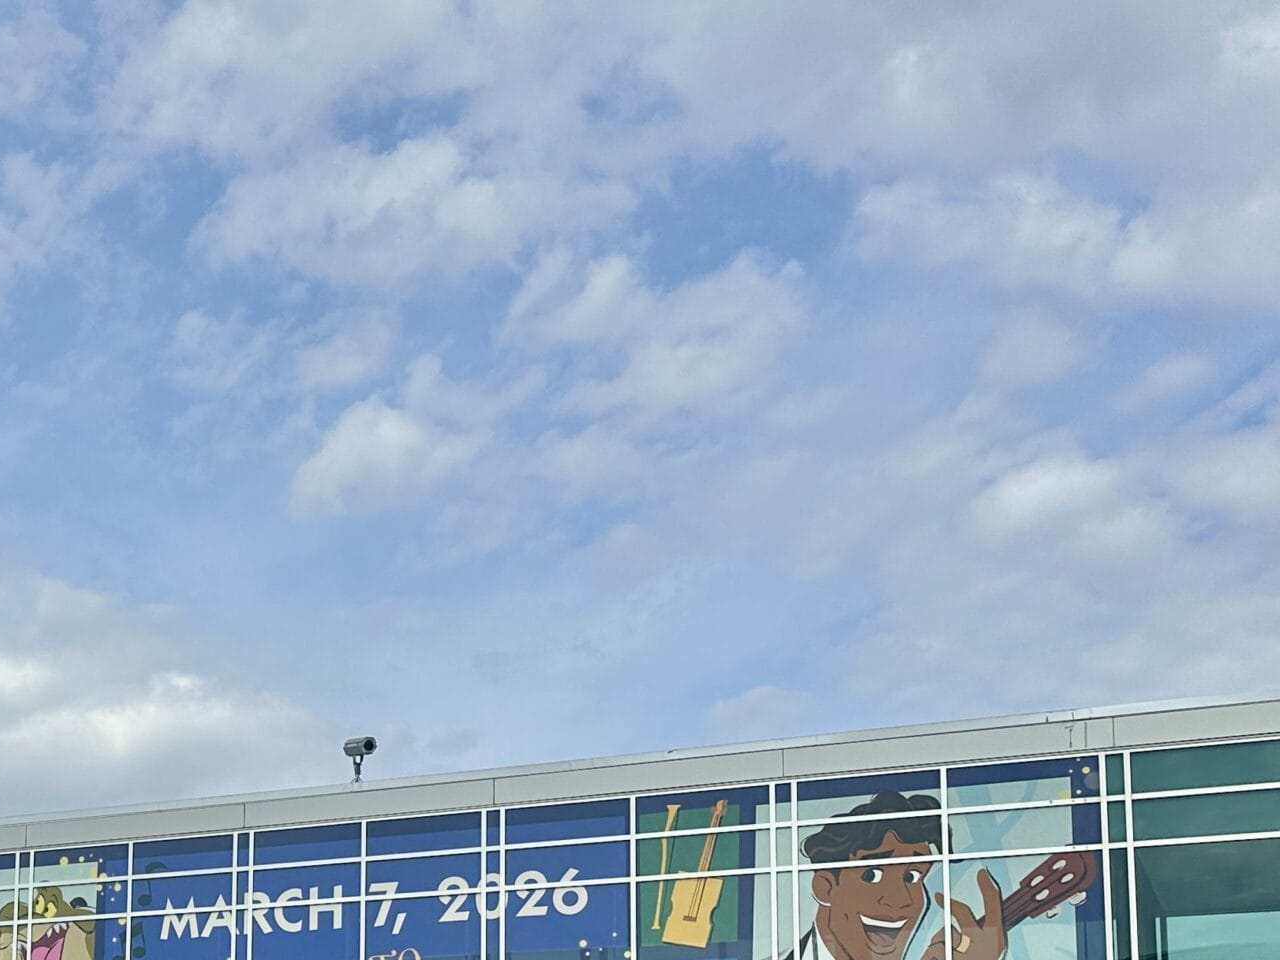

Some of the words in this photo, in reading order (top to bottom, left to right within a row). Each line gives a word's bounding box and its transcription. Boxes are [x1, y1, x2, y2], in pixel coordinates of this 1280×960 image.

[160, 884, 343, 940] MARCH
[368, 881, 407, 935] 7,
[437, 868, 589, 923] 2026
